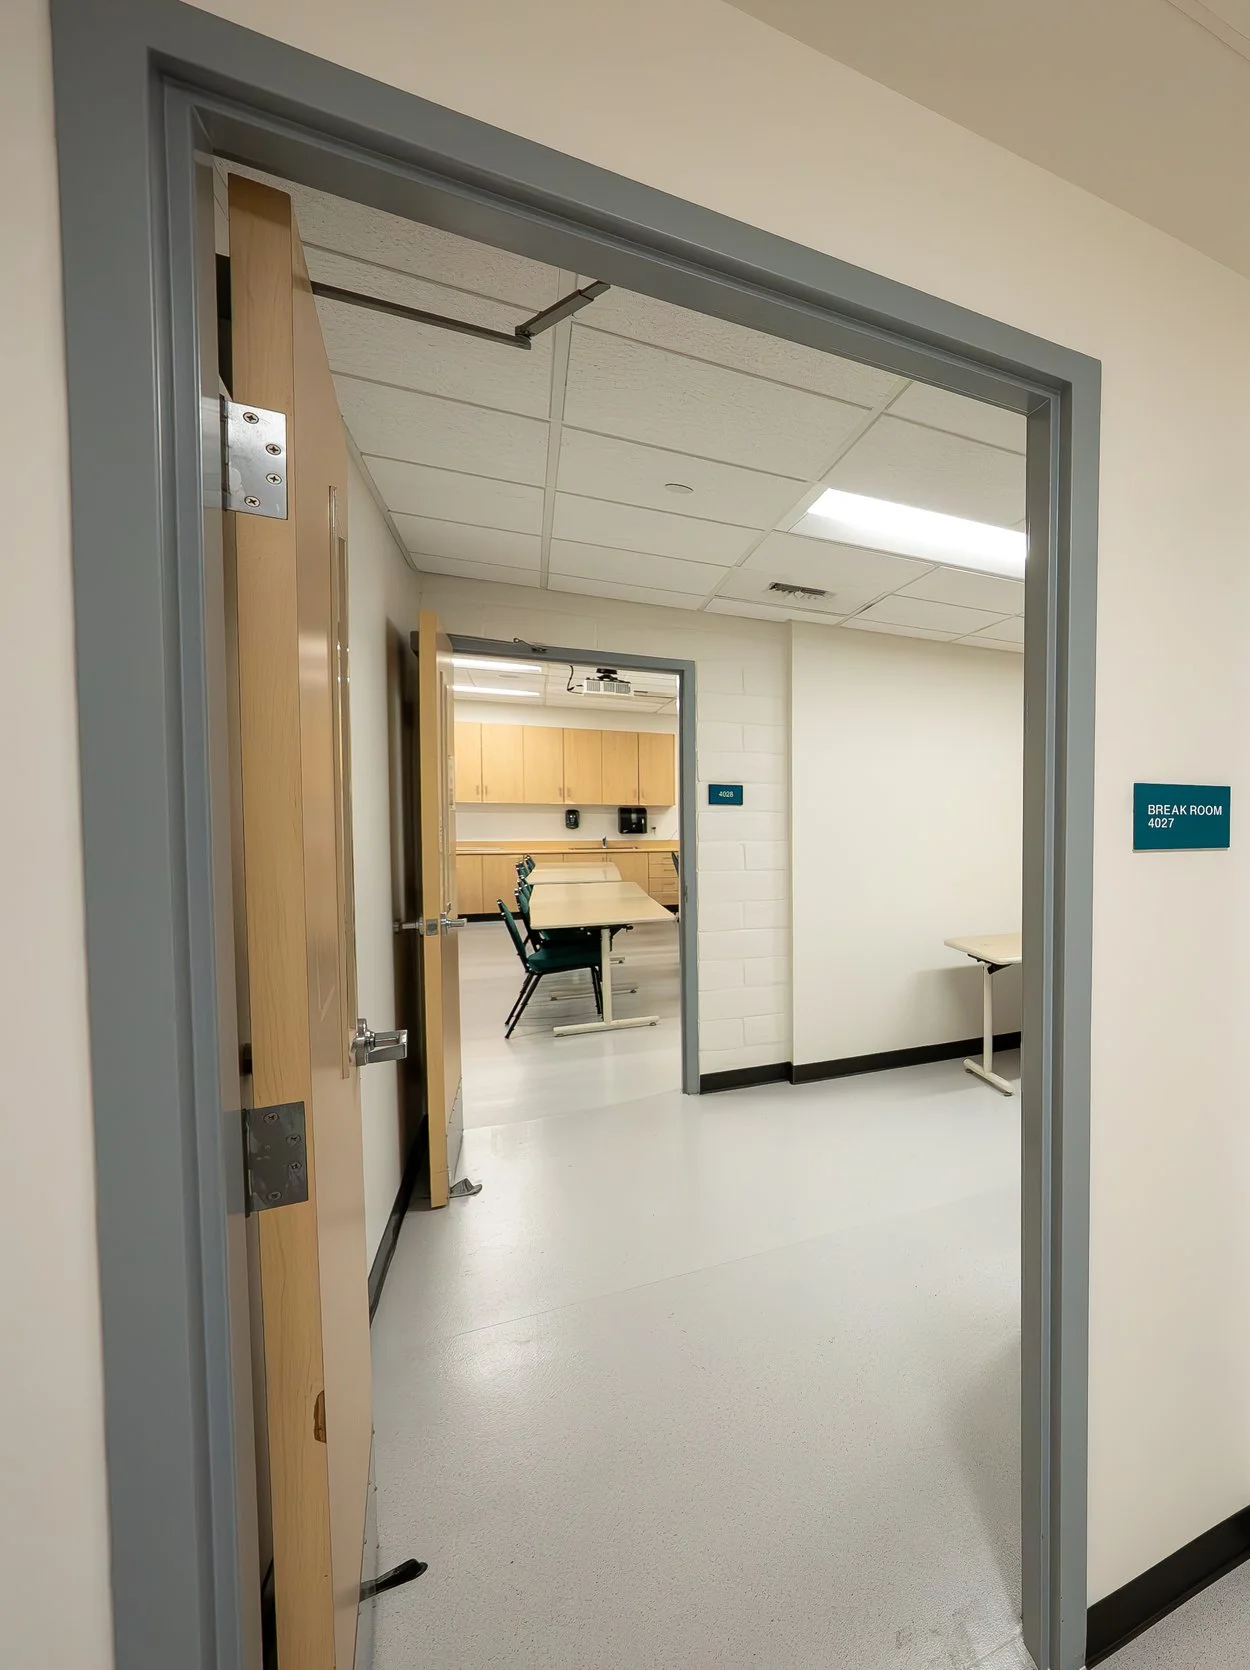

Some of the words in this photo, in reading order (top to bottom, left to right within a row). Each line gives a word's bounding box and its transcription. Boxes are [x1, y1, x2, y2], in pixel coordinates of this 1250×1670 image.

[1147, 804, 1187, 815] BREAK
[1190, 805, 1222, 815] ROOM
[1147, 818, 1175, 828] 4027
